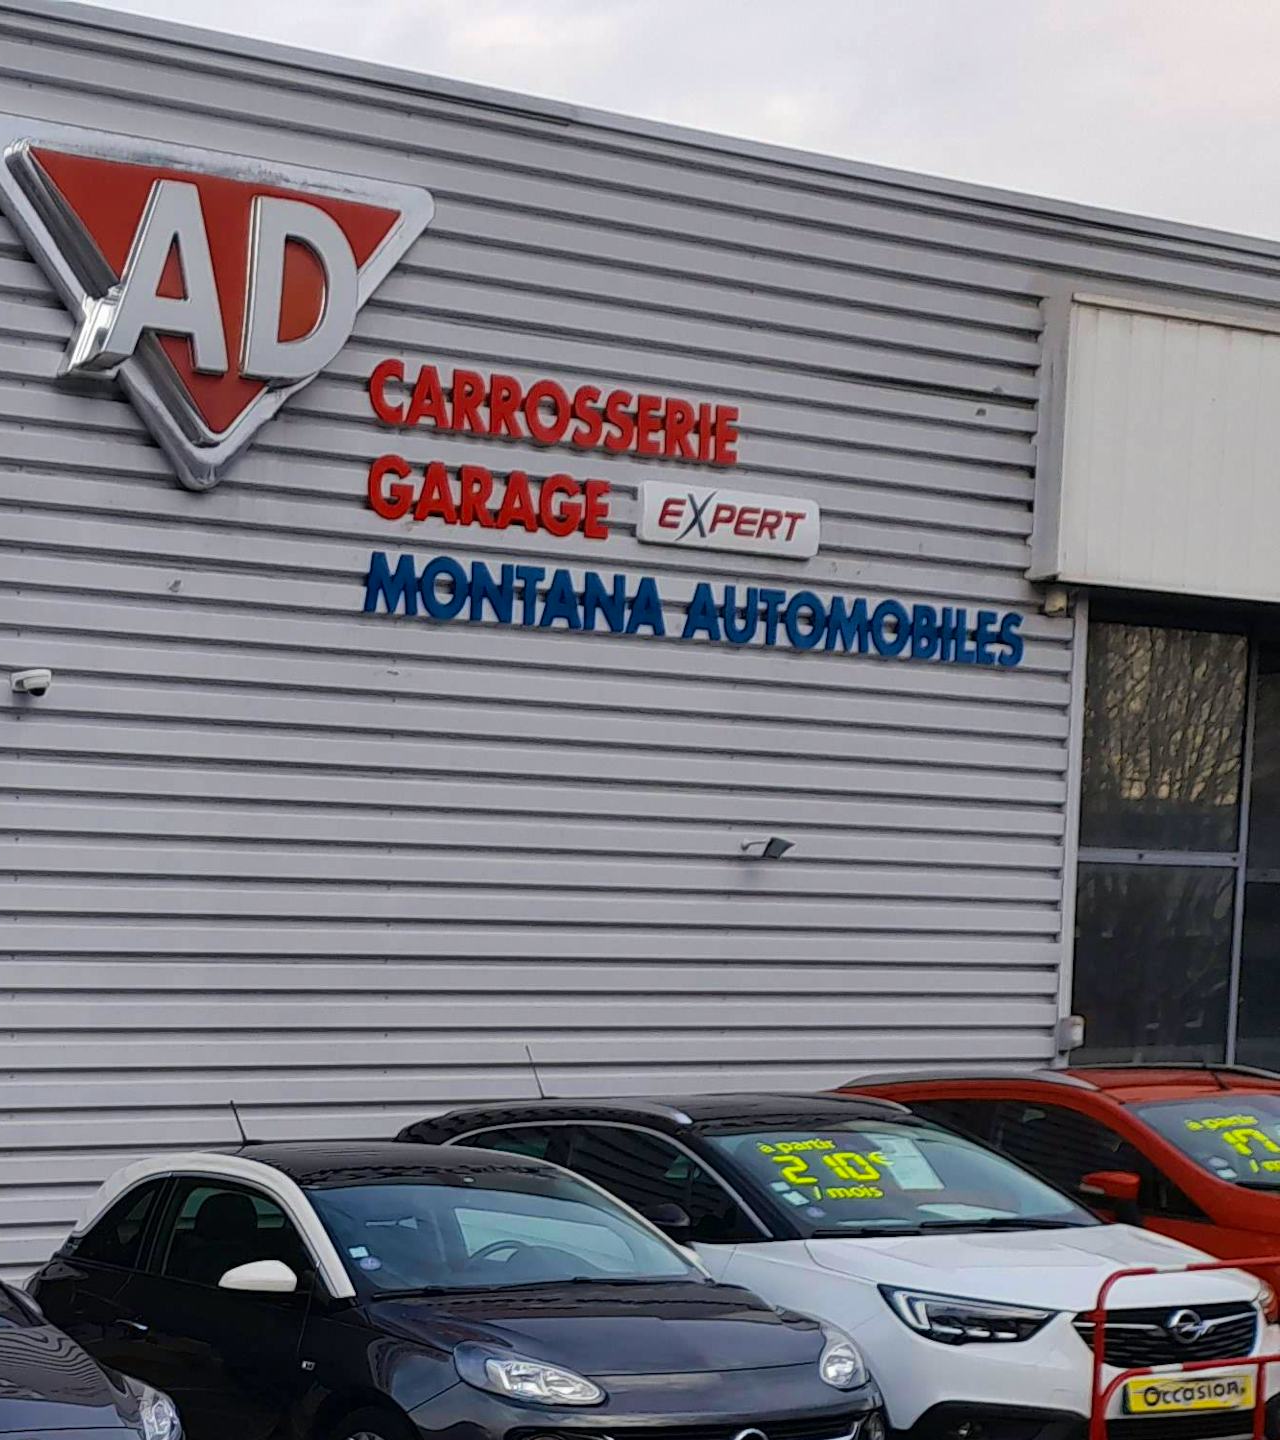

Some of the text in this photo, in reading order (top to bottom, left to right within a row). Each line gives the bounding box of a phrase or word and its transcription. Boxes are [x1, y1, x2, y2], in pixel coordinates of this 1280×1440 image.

[95, 178, 359, 378] AD
[368, 358, 740, 466] CARROSSERIE
[367, 454, 611, 540] GARAGE
[658, 490, 807, 543] EXPERT
[363, 550, 1025, 667] MONTANA AUTOMOBILES
[775, 1137, 837, 1154] partir
[826, 1183, 884, 1199] mois
